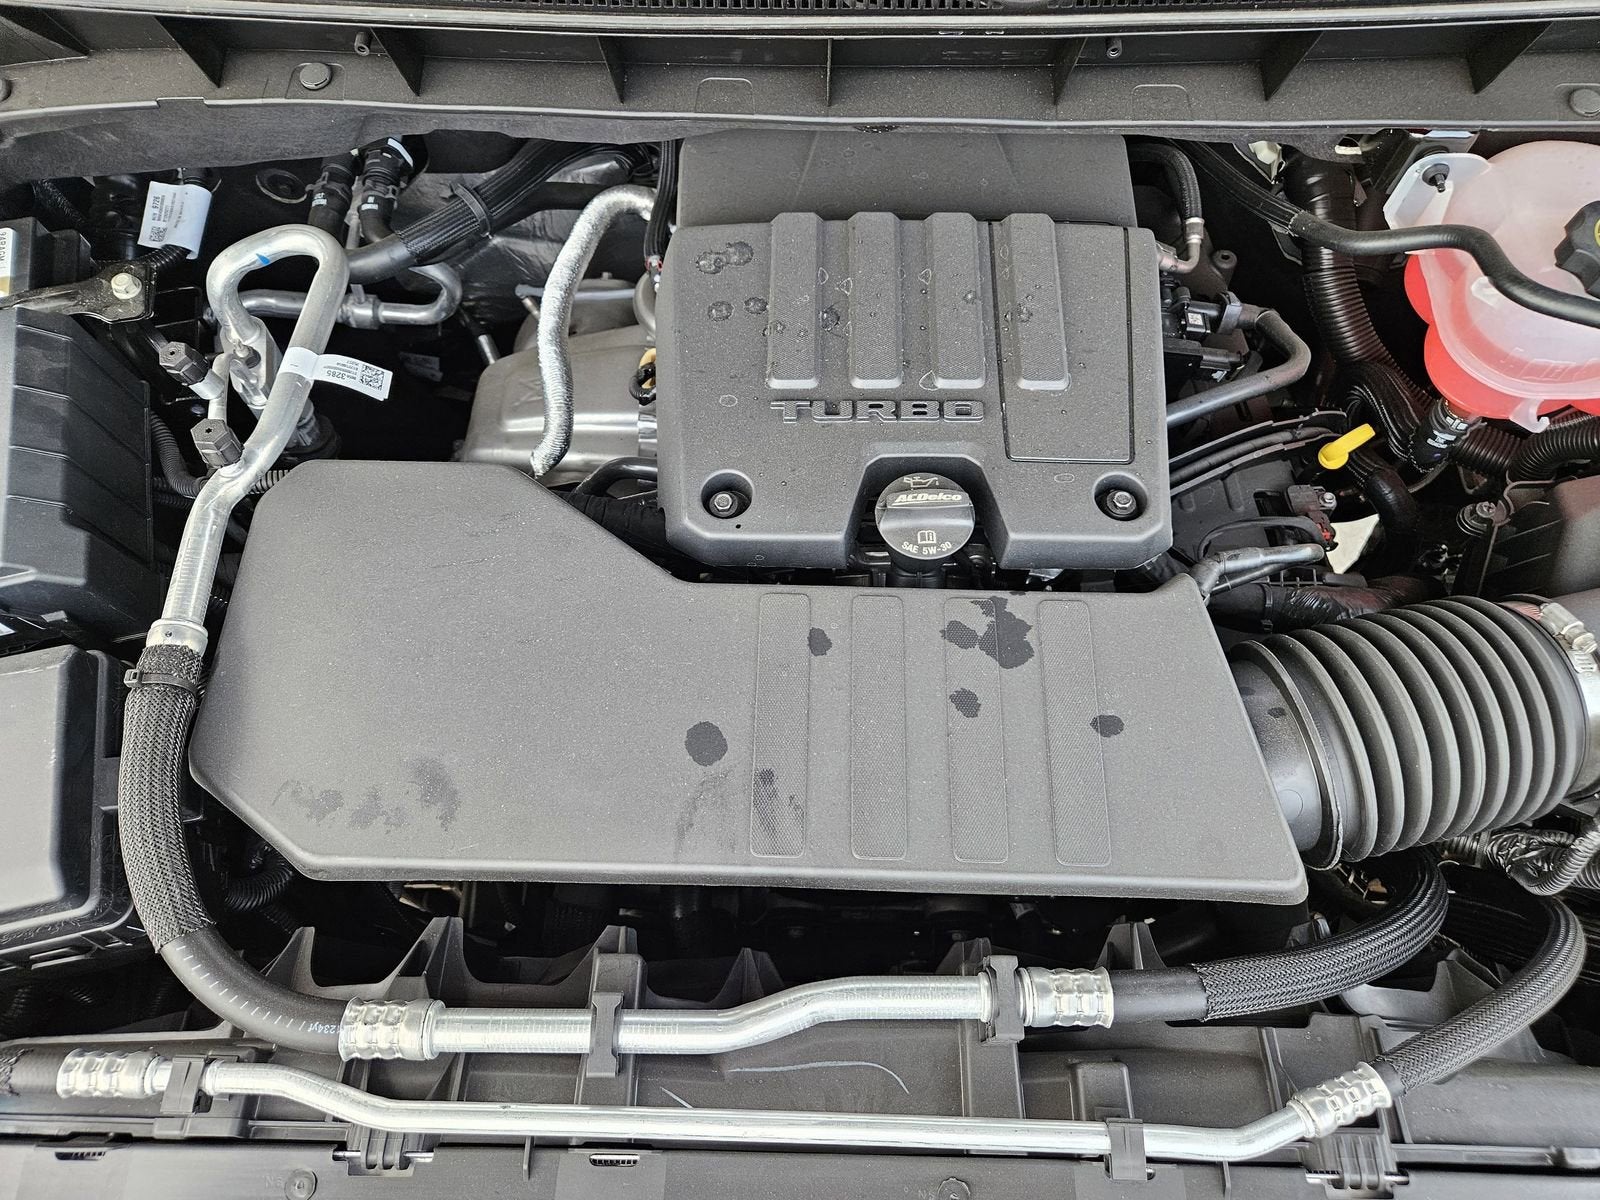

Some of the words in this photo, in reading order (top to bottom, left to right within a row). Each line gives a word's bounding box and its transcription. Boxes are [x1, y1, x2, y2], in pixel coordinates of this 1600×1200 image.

[326, 370, 346, 380] 3285
[770, 400, 984, 423] TURBO
[894, 493, 962, 503] ACDelco
[901, 541, 919, 554] SAE
[922, 541, 952, 555] 5W-30
